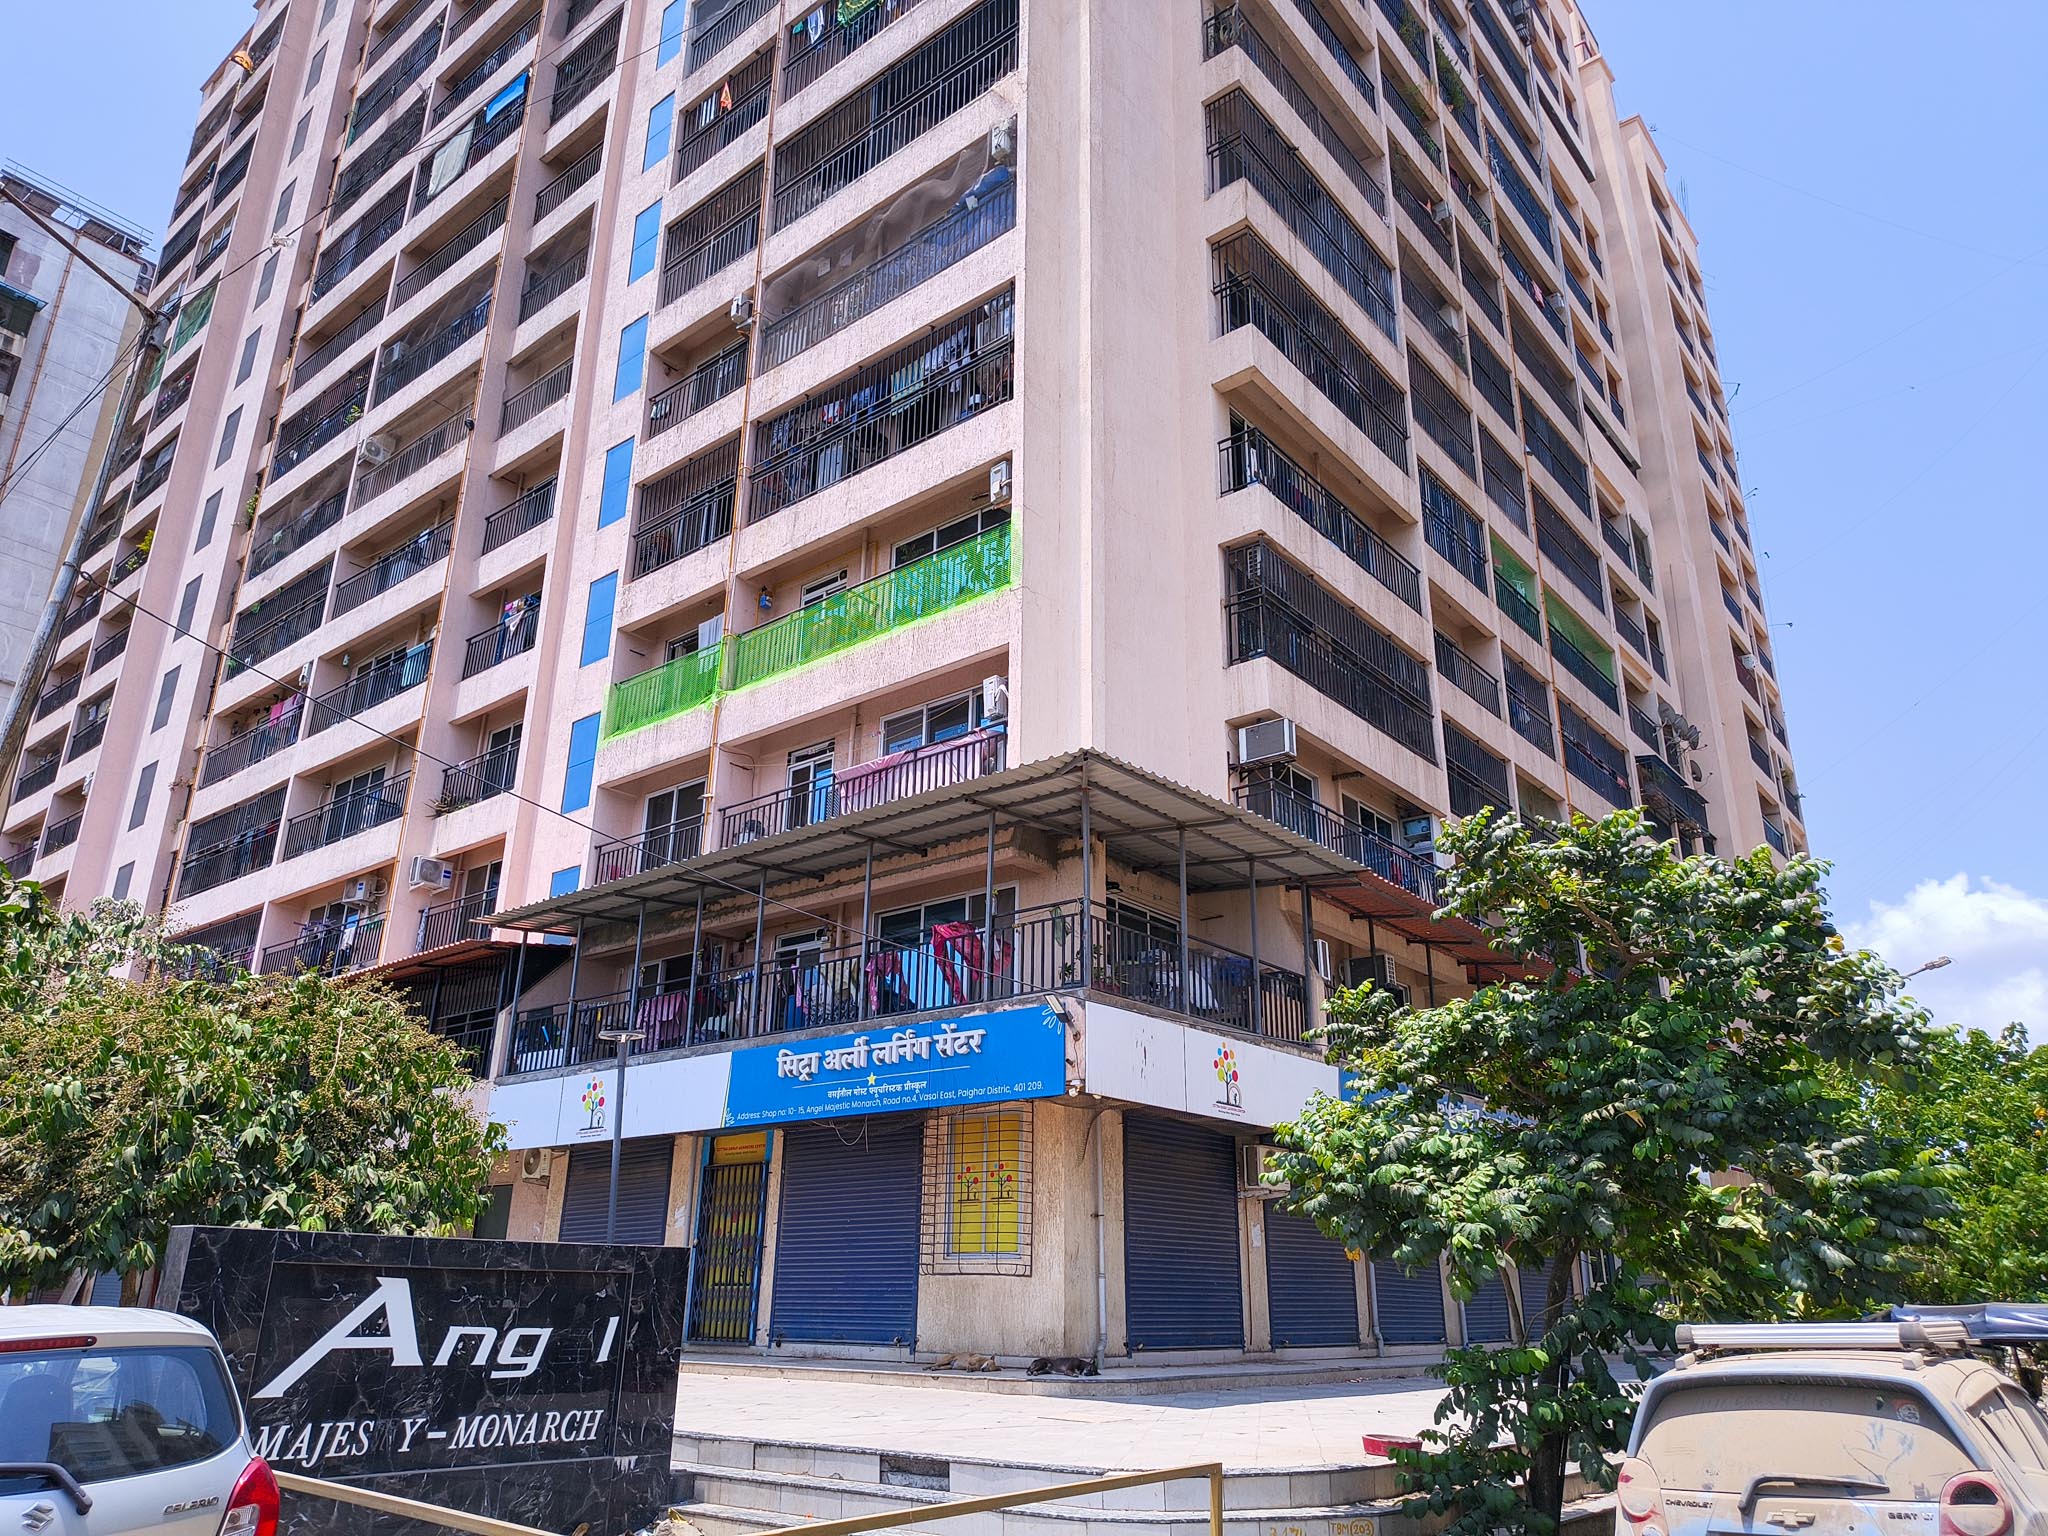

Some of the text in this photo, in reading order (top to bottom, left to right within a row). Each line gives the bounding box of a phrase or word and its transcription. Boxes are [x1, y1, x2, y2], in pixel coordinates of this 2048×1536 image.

[776, 1023, 987, 1082] सिट्रा अर्ली लर्निंग सेंटर
[762, 1109, 777, 1120] Shop
[806, 1104, 824, 1116] Angel
[825, 1101, 851, 1113] Majestic
[851, 1098, 882, 1109] Monarch,
[883, 1095, 901, 1104] Road
[940, 1090, 957, 1100] East,
[957, 1087, 986, 1099] Palghar
[987, 1084, 1012, 1096] Distric,
[1013, 1083, 1026, 1092] 401
[1027, 1081, 1044, 1091] 209.
[162, 1495, 220, 1516] CELERIO
[1665, 1499, 1713, 1509] CHEVROLET
